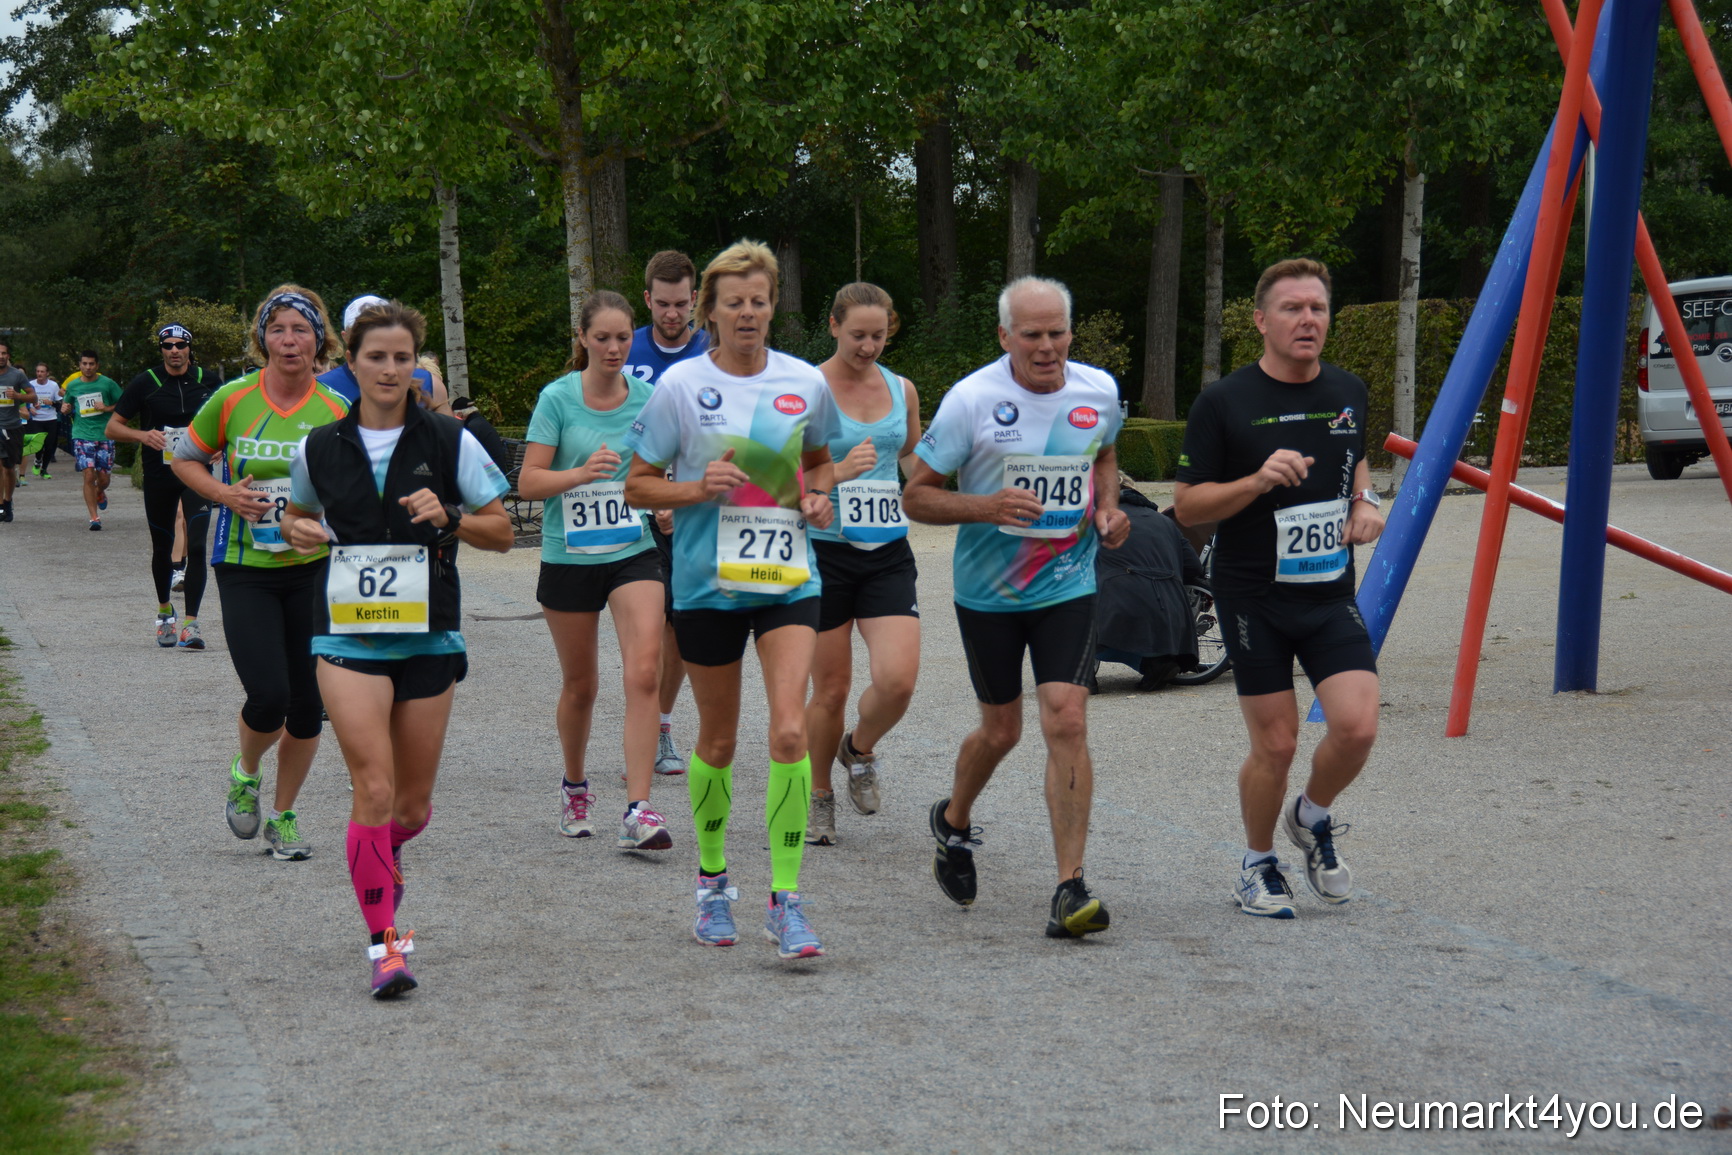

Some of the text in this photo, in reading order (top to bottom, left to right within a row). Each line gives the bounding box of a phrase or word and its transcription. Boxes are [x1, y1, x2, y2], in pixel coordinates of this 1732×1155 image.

[994, 429, 1022, 438] PARTL
[994, 436, 1023, 444] Neumarkt
[1006, 463, 1079, 472] PARTL Neumarkt
[563, 490, 591, 499] PARTL
[867, 486, 897, 495] Neumarkt
[571, 499, 633, 528] 3104
[848, 497, 902, 524] 3103
[1278, 508, 1342, 524] PARTL Neumarkt
[721, 515, 795, 527] PARTL Neumarkt
[1287, 518, 1344, 554] 2688
[738, 528, 793, 561] 273
[334, 554, 412, 563] PARTL Neumarkt
[1298, 558, 1339, 572] Manfred
[750, 567, 783, 581] Heidi
[358, 566, 398, 598] 62
[355, 607, 400, 620] Kerstin
